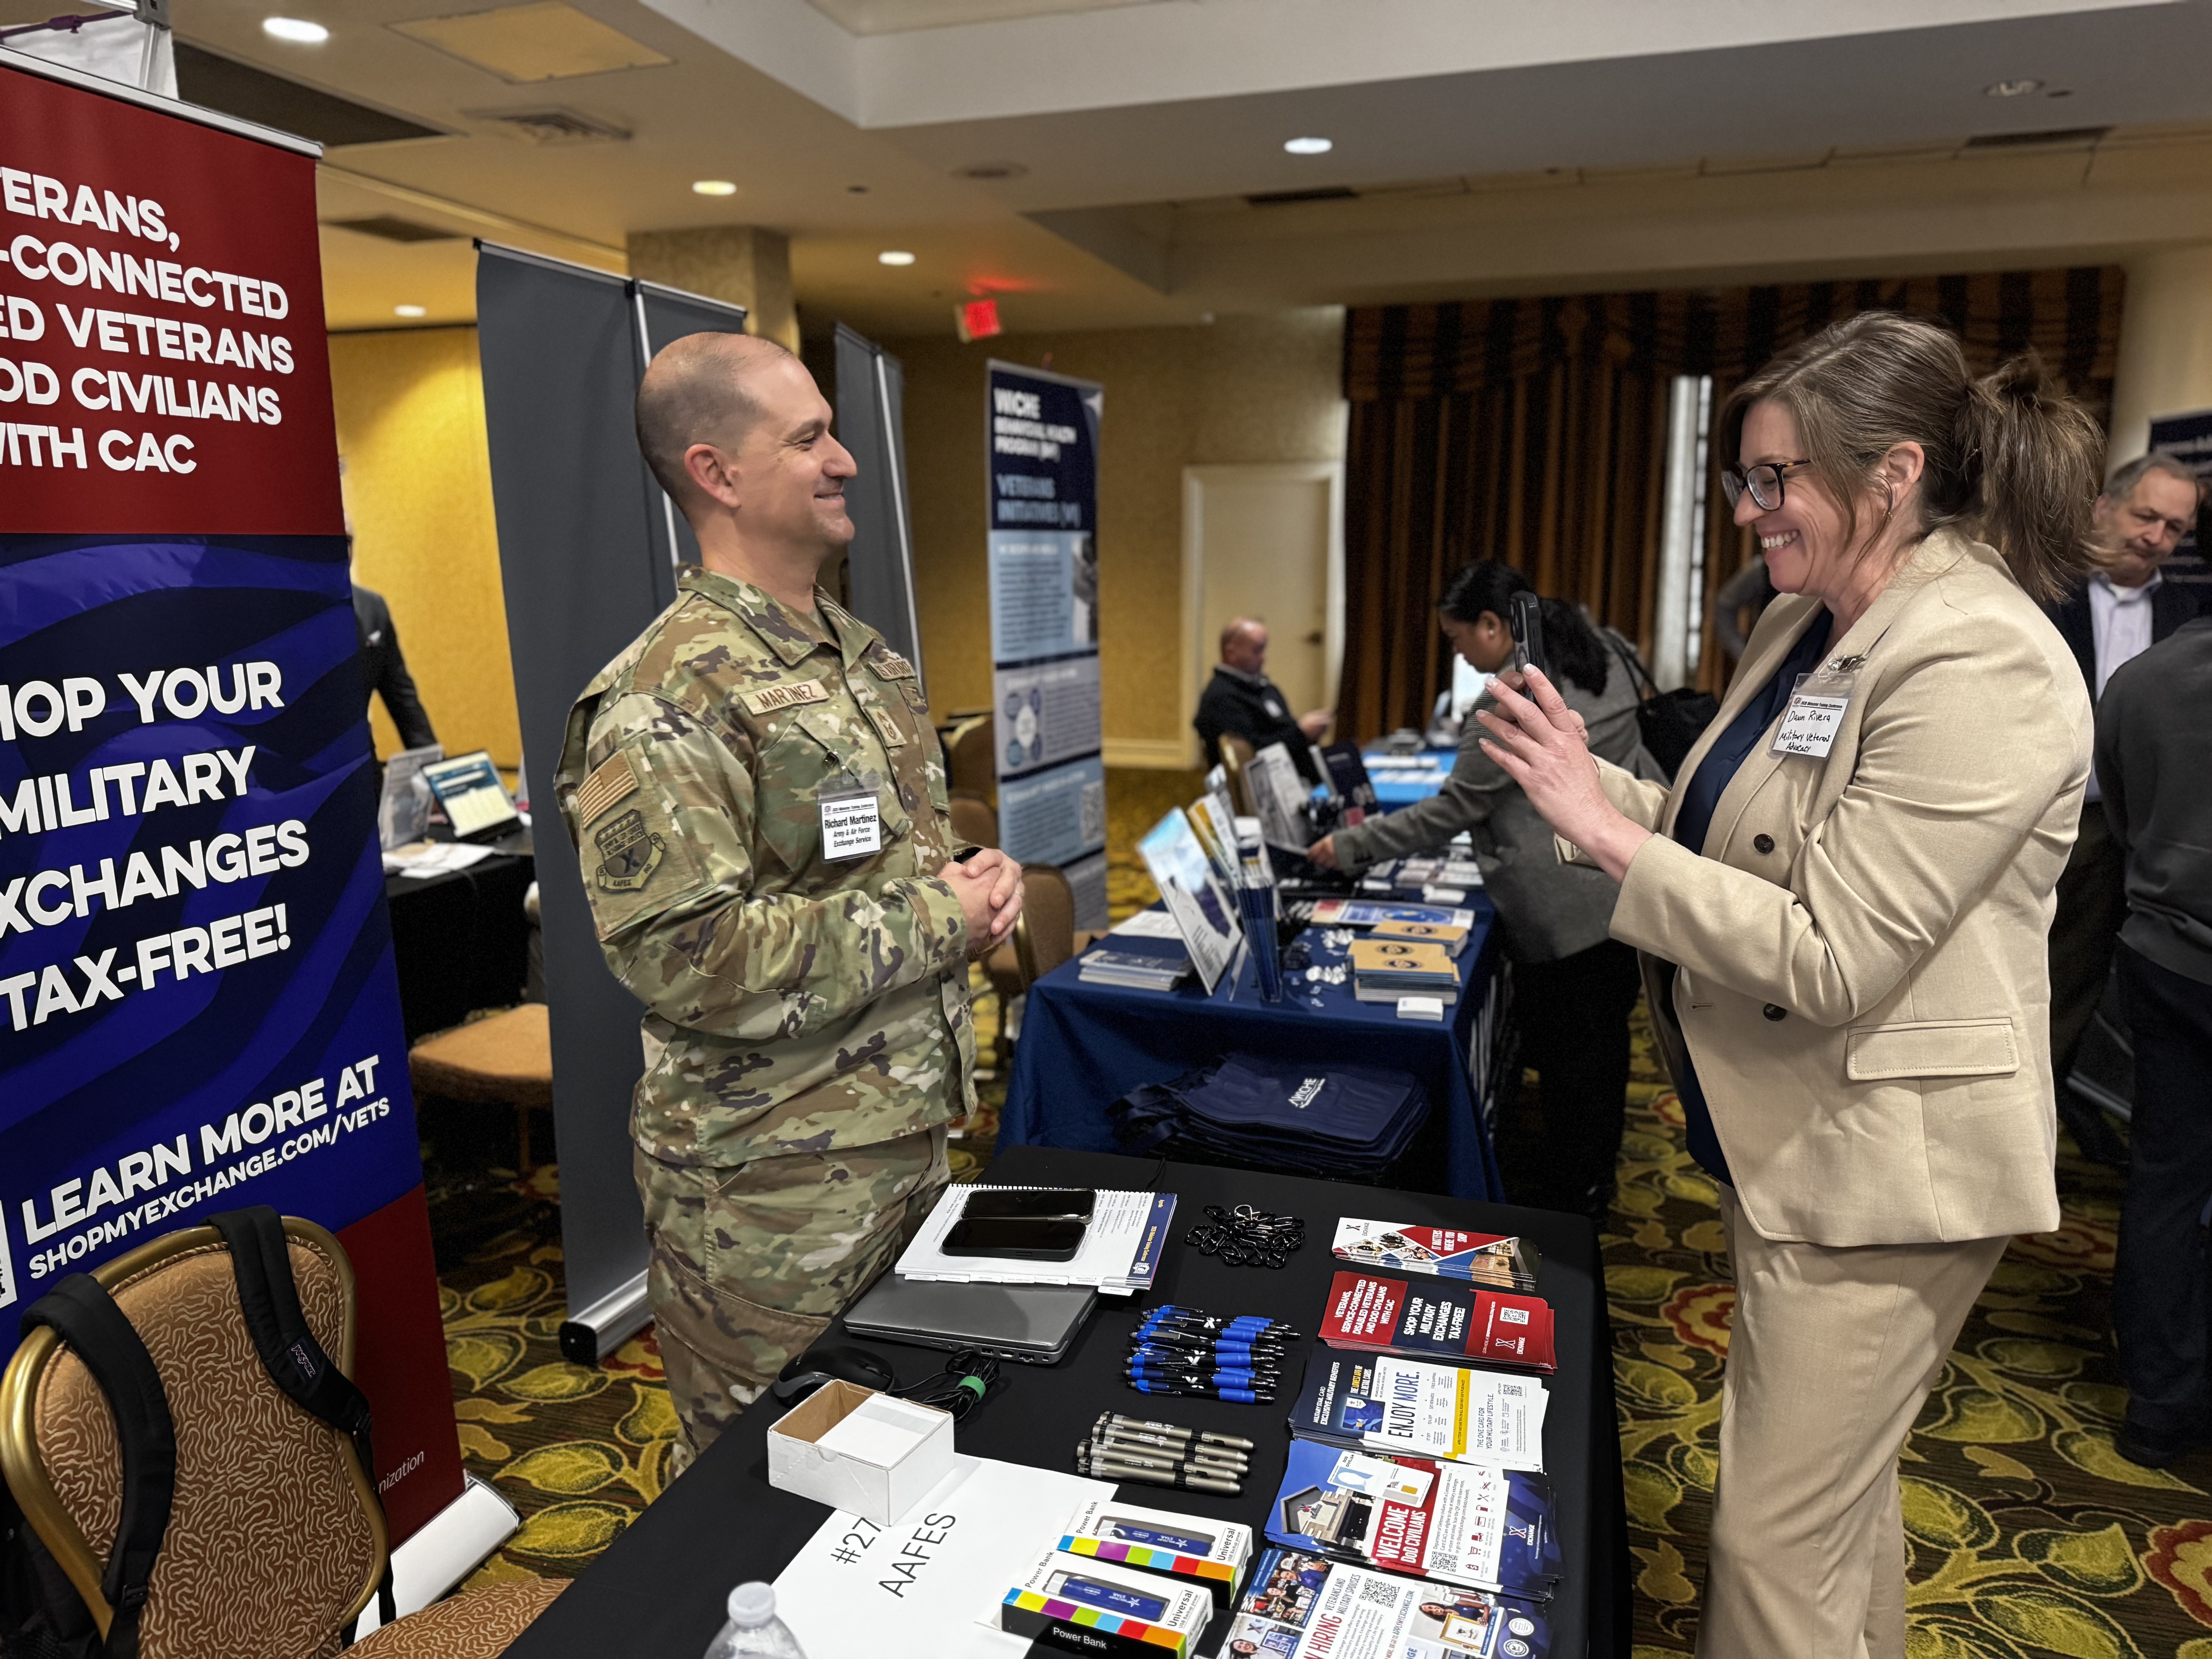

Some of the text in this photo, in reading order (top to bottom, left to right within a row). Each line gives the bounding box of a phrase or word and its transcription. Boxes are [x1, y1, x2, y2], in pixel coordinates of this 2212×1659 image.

[0, 167, 180, 252] ERANS,
[56, 303, 294, 373] VETERANS
[72, 368, 282, 425] CIVILIANS
[0, 422, 197, 473] ITH CAC
[118, 661, 284, 723] YOUR
[1808, 710, 1831, 722] Rivera
[1786, 742, 1811, 753] Advocacy
[824, 814, 877, 829] Richard Martinez
[0, 903, 290, 1031] TAX-FREE!
[22, 1055, 379, 1245] LEARN MORE AT
[28, 1098, 389, 1279] SHOPMYEXCHANGE.COM/VETS
[1443, 1238, 1455, 1252] WHERE
[1334, 1289, 1353, 1319] VETERANS,
[1341, 1279, 1367, 1333] SERVICE-CONNECTED
[1352, 1281, 1377, 1334] DISABLED VETERANS
[1365, 1285, 1388, 1334] AND DOD CIVILIANS
[1380, 1298, 1395, 1325] WITH CAC
[1403, 1297, 1424, 1336] SHOP YOUR
[1419, 1303, 1437, 1334] MILITARY
[1432, 1300, 1452, 1341] EXCHANGES
[1448, 1306, 1466, 1340] TAX-FREE!
[291, 1345, 316, 1377] JANSPORT
[1516, 1336, 1526, 1355] EXCHANGE
[1321, 1361, 1340, 1425] EXCLUSIVE MILITARY BENEFITS
[1388, 1368, 1420, 1439] ENJOY MORE.
[1313, 1406, 1321, 1423] MILITARY
[1346, 1454, 1355, 1467] CIVILIAN
[1076, 1501, 1099, 1534] Power Bank
[1376, 1505, 1409, 1561] WELCOME
[1404, 1509, 1427, 1547] CIVILIANS
[1527, 1523, 1535, 1546] EXCHANGE
[830, 1517, 882, 1564] #27
[878, 1513, 956, 1598] AAFES
[1216, 1527, 1236, 1561] Universal
[1401, 1545, 1419, 1564] DoD
[1432, 1530, 1441, 1549] Department
[1025, 1551, 1055, 1588] Power Bank
[1167, 1589, 1194, 1627] Universal
[1189, 1594, 1199, 1609] power
[1324, 1577, 1346, 1612] VETERANS AND
[1336, 1573, 1361, 1615] MILITARY SPOUSES
[1053, 1627, 1108, 1650] Power Bank
[1307, 1611, 1343, 1655] HIRING
